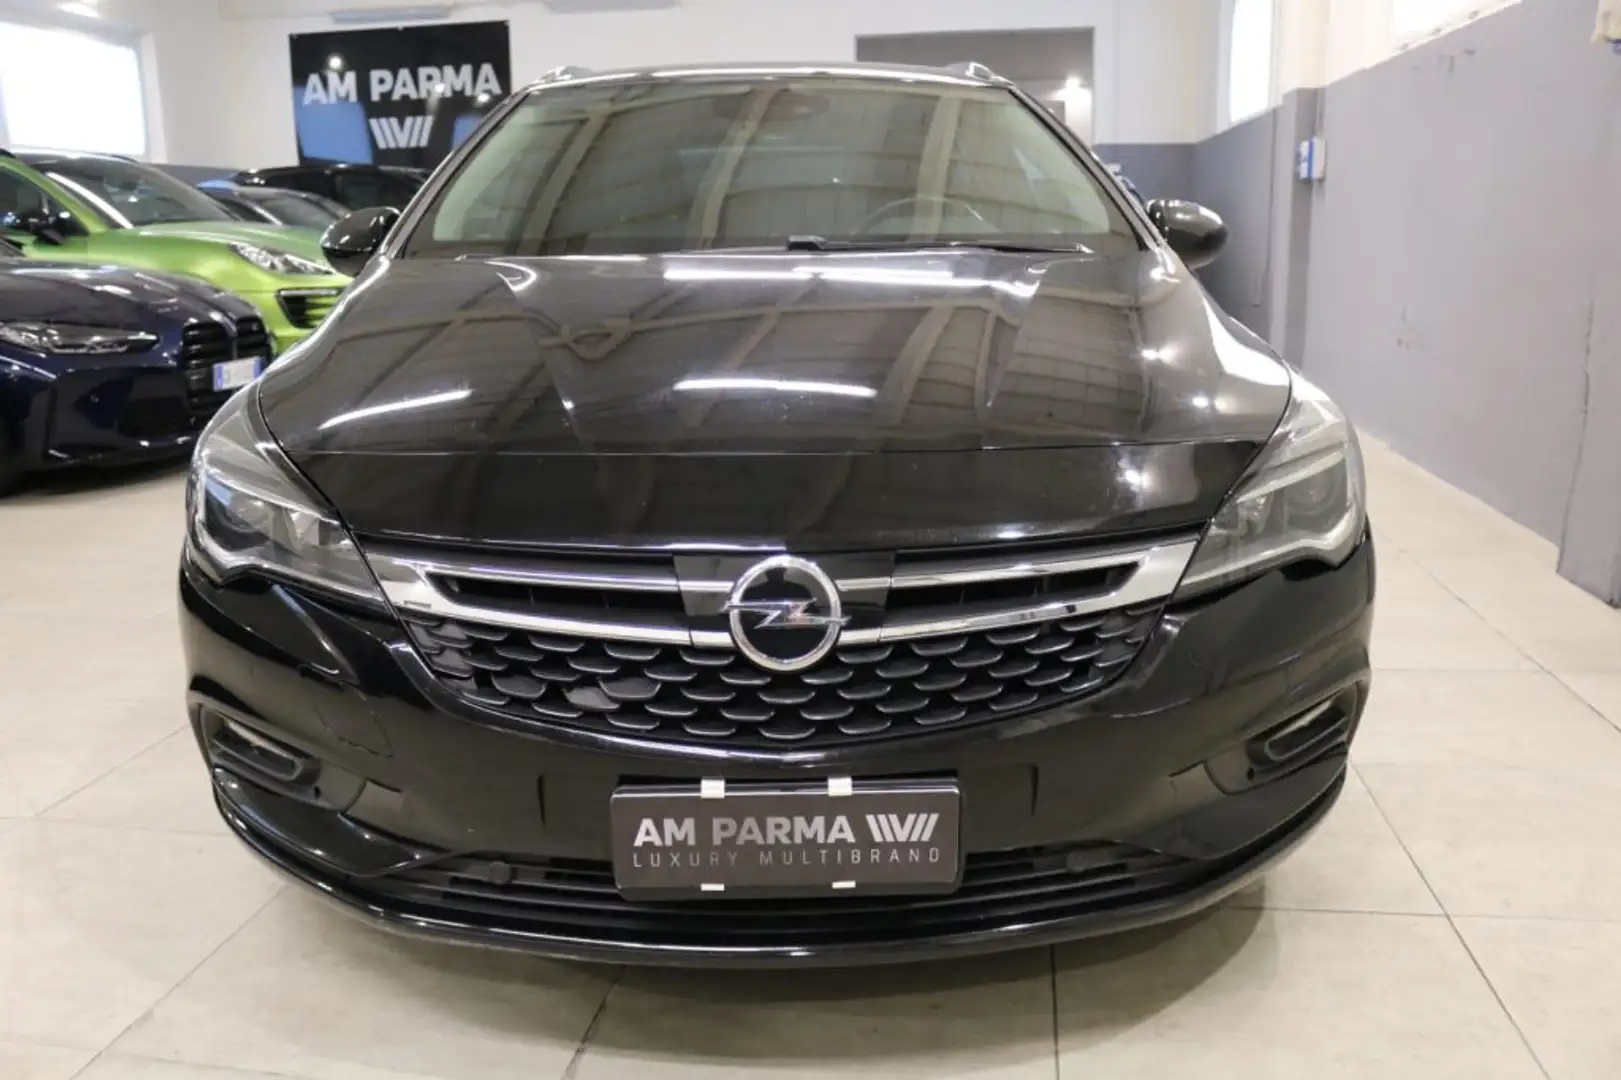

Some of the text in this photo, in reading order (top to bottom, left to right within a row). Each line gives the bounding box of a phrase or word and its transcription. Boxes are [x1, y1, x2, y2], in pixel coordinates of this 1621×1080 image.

[303, 62, 502, 105] AM PARMA
[633, 815, 856, 847] AM PARMA
[633, 847, 940, 868] LUXURY MULTIBRAND
